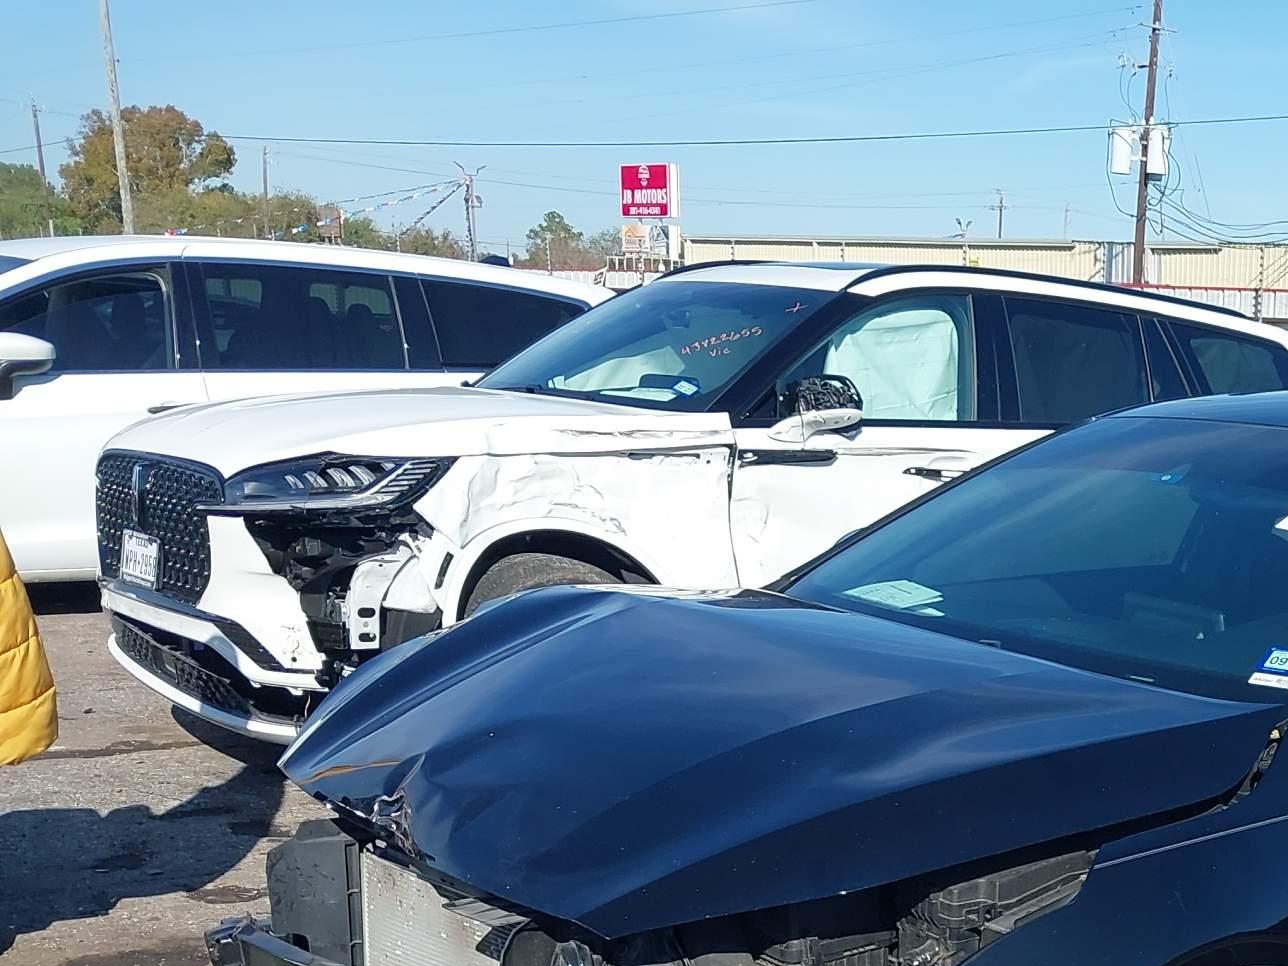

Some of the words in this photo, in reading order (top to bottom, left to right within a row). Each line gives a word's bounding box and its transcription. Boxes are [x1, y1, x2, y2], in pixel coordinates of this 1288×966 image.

[623, 189, 633, 204] JB
[634, 188, 667, 204] MOTORS
[1269, 656, 1288, 666] 09
